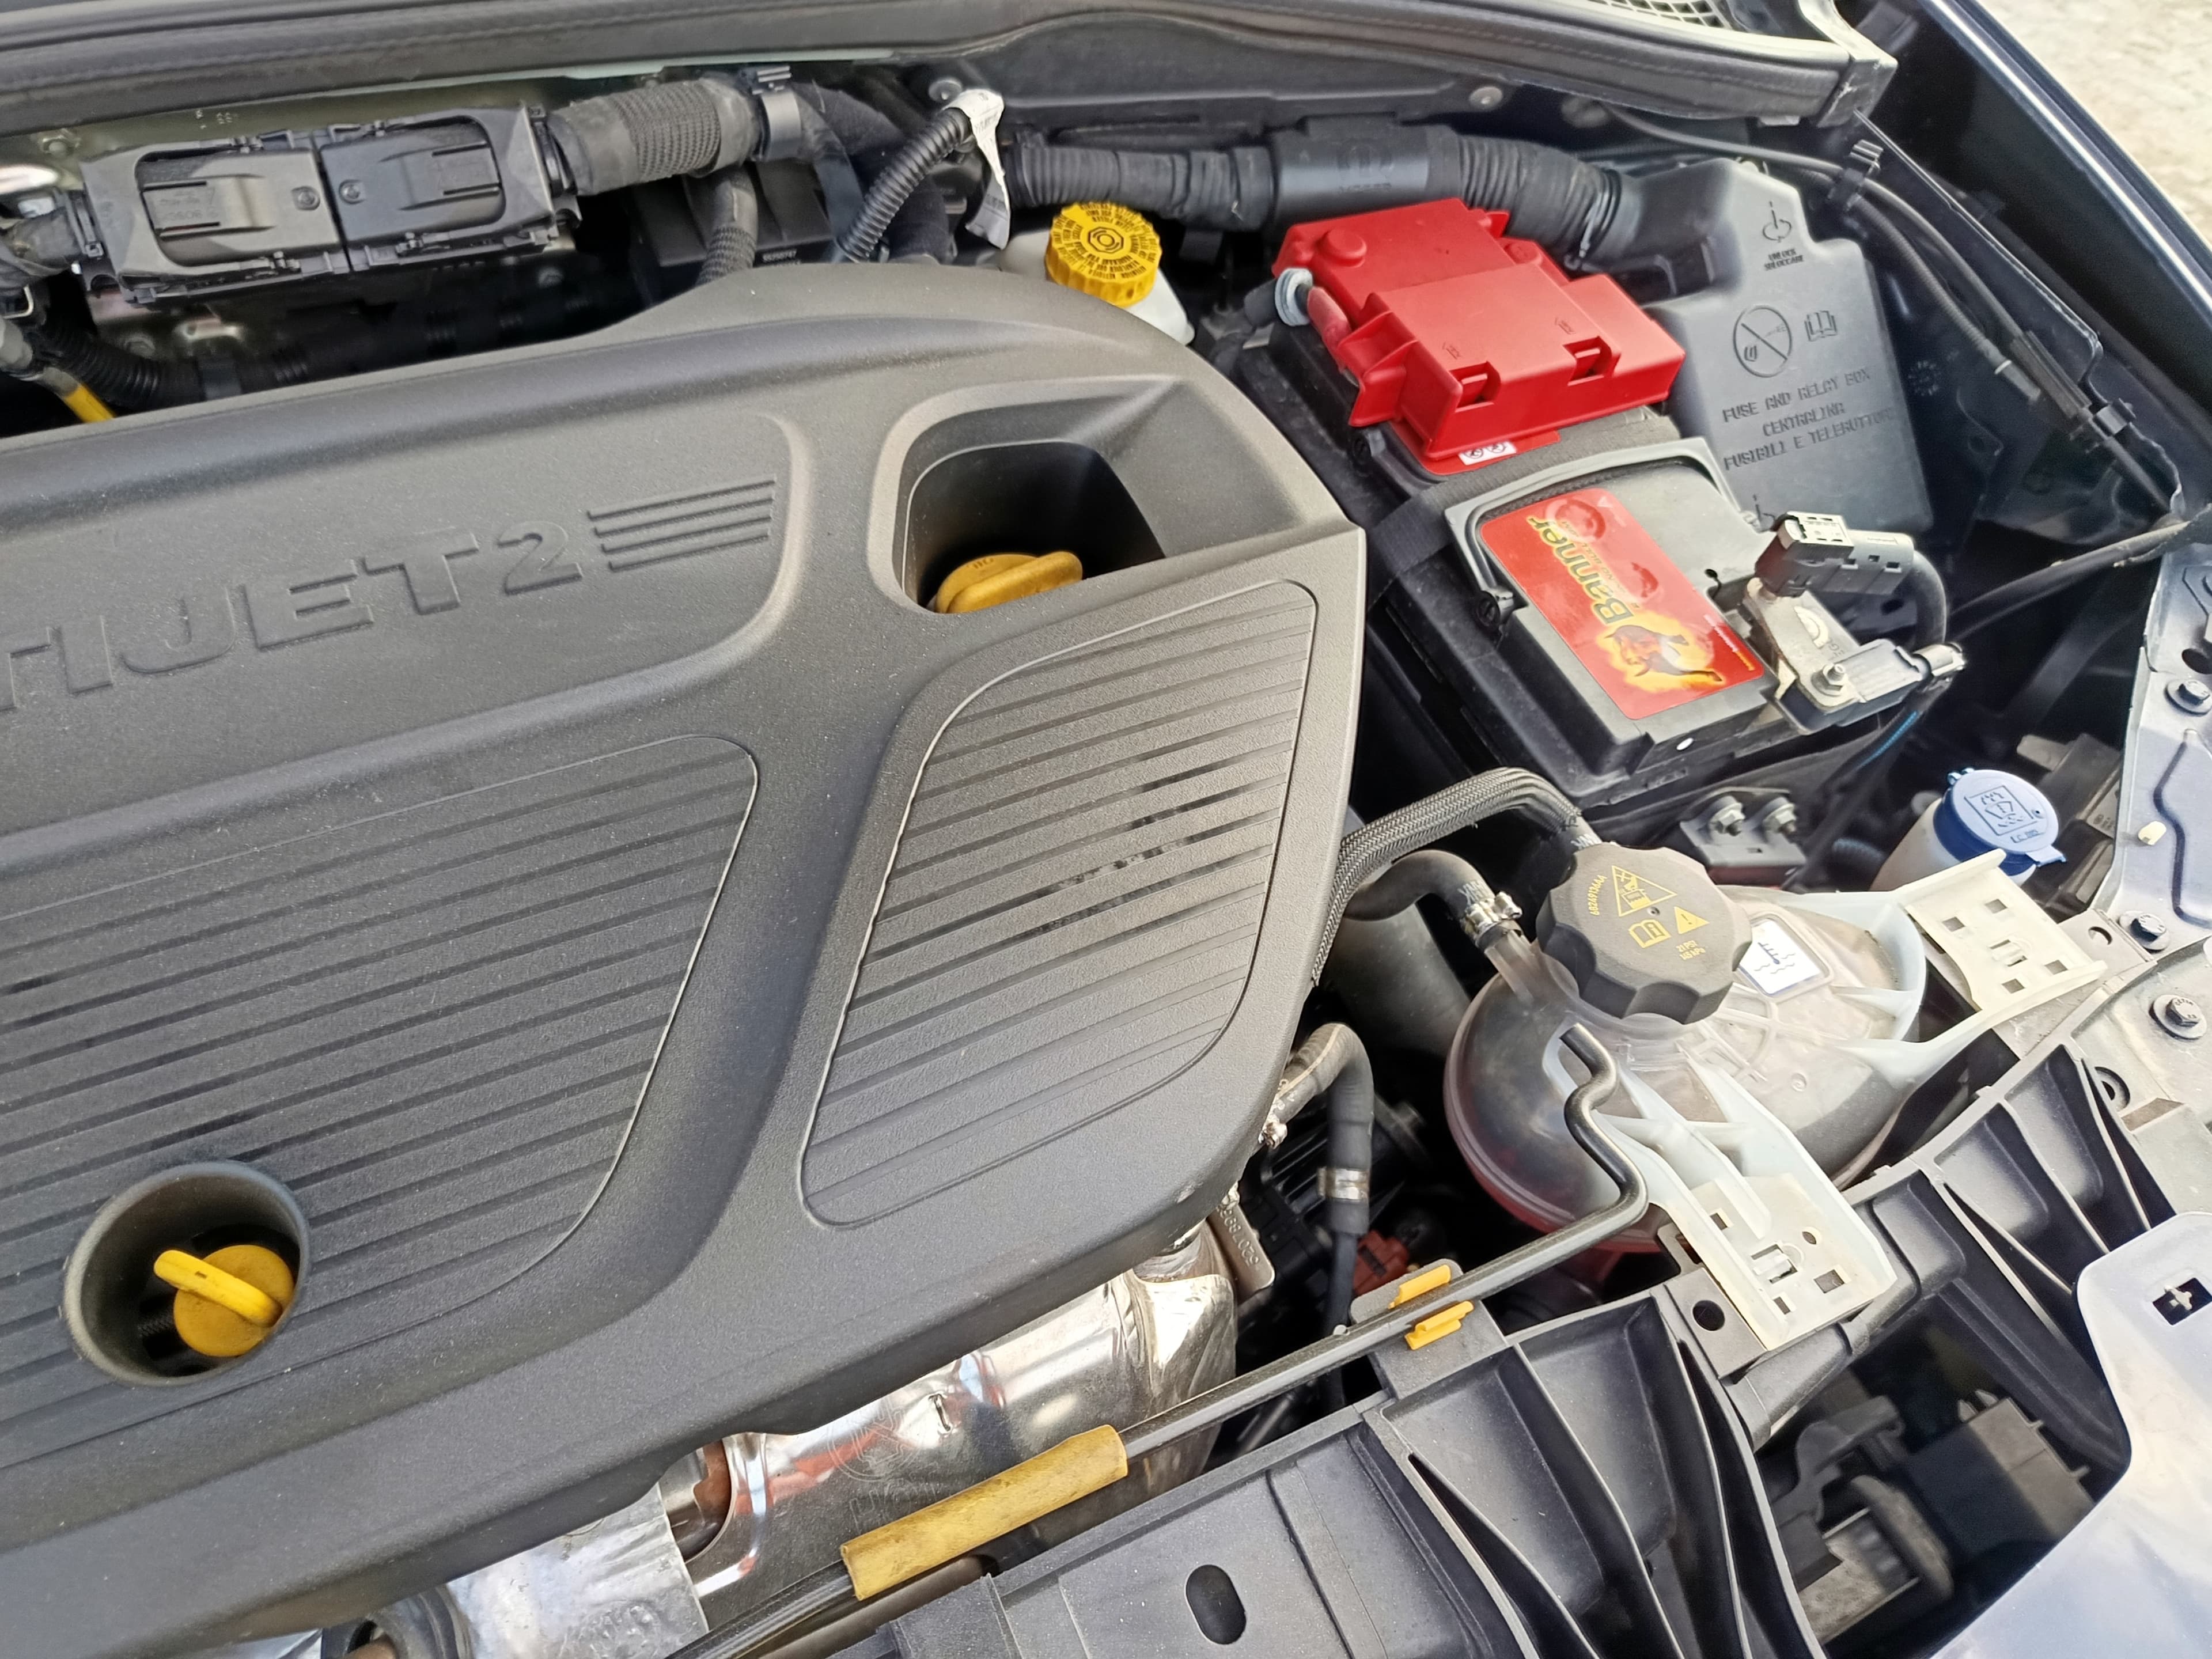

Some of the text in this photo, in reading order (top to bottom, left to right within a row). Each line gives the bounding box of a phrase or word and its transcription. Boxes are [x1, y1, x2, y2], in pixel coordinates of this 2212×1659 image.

[1722, 402, 1760, 423] FUSE
[1764, 392, 1792, 410] AND
[1797, 377, 1840, 400] RELAY
[1762, 402, 1846, 437] CENTRALINA
[1723, 441, 1788, 471] FUSIBILI
[1793, 436, 1805, 449] E
[1528, 517, 1634, 626] Banner
[1587, 874, 1608, 916] 68249136AA
